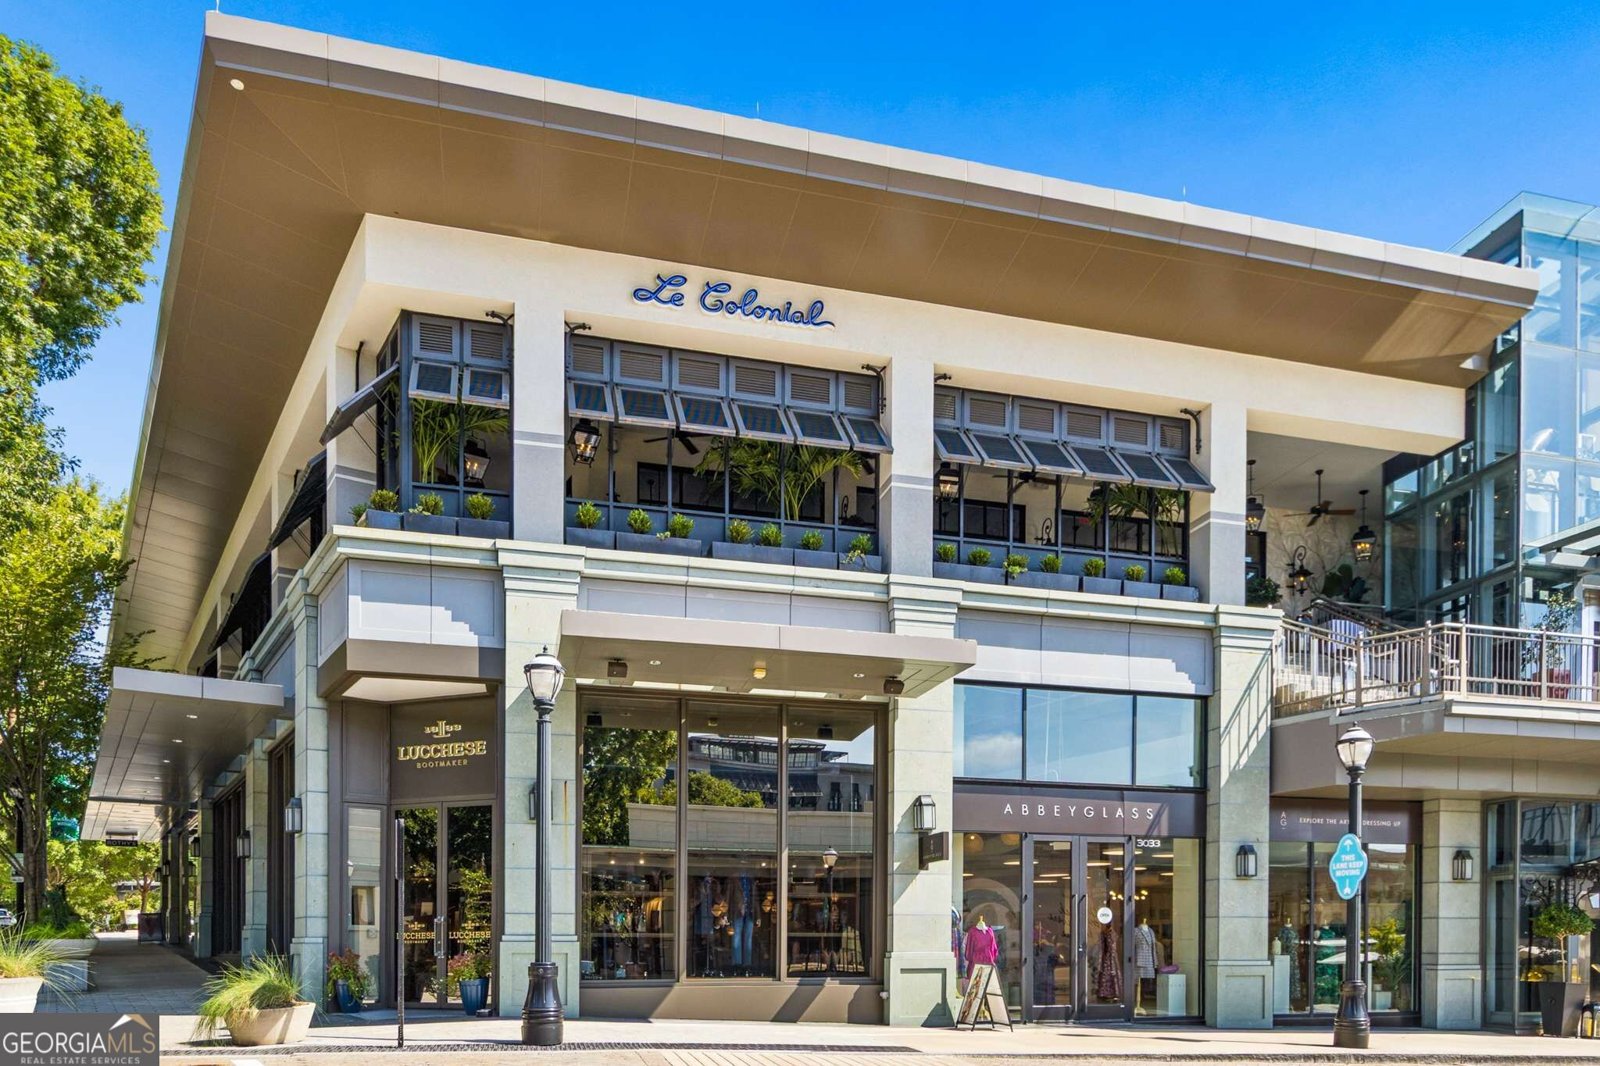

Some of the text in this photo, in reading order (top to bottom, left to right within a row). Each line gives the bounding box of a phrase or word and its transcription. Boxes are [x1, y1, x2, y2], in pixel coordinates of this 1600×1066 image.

[633, 273, 835, 328] Le Colonial
[397, 741, 486, 761] LUCCHESE
[416, 760, 468, 769] BOOTMAKER
[1003, 803, 1154, 820] ABBEYGLASS
[1362, 819, 1391, 827] DRESSING
[1136, 839, 1161, 848] 3033
[448, 931, 491, 939] LUCCHESE
